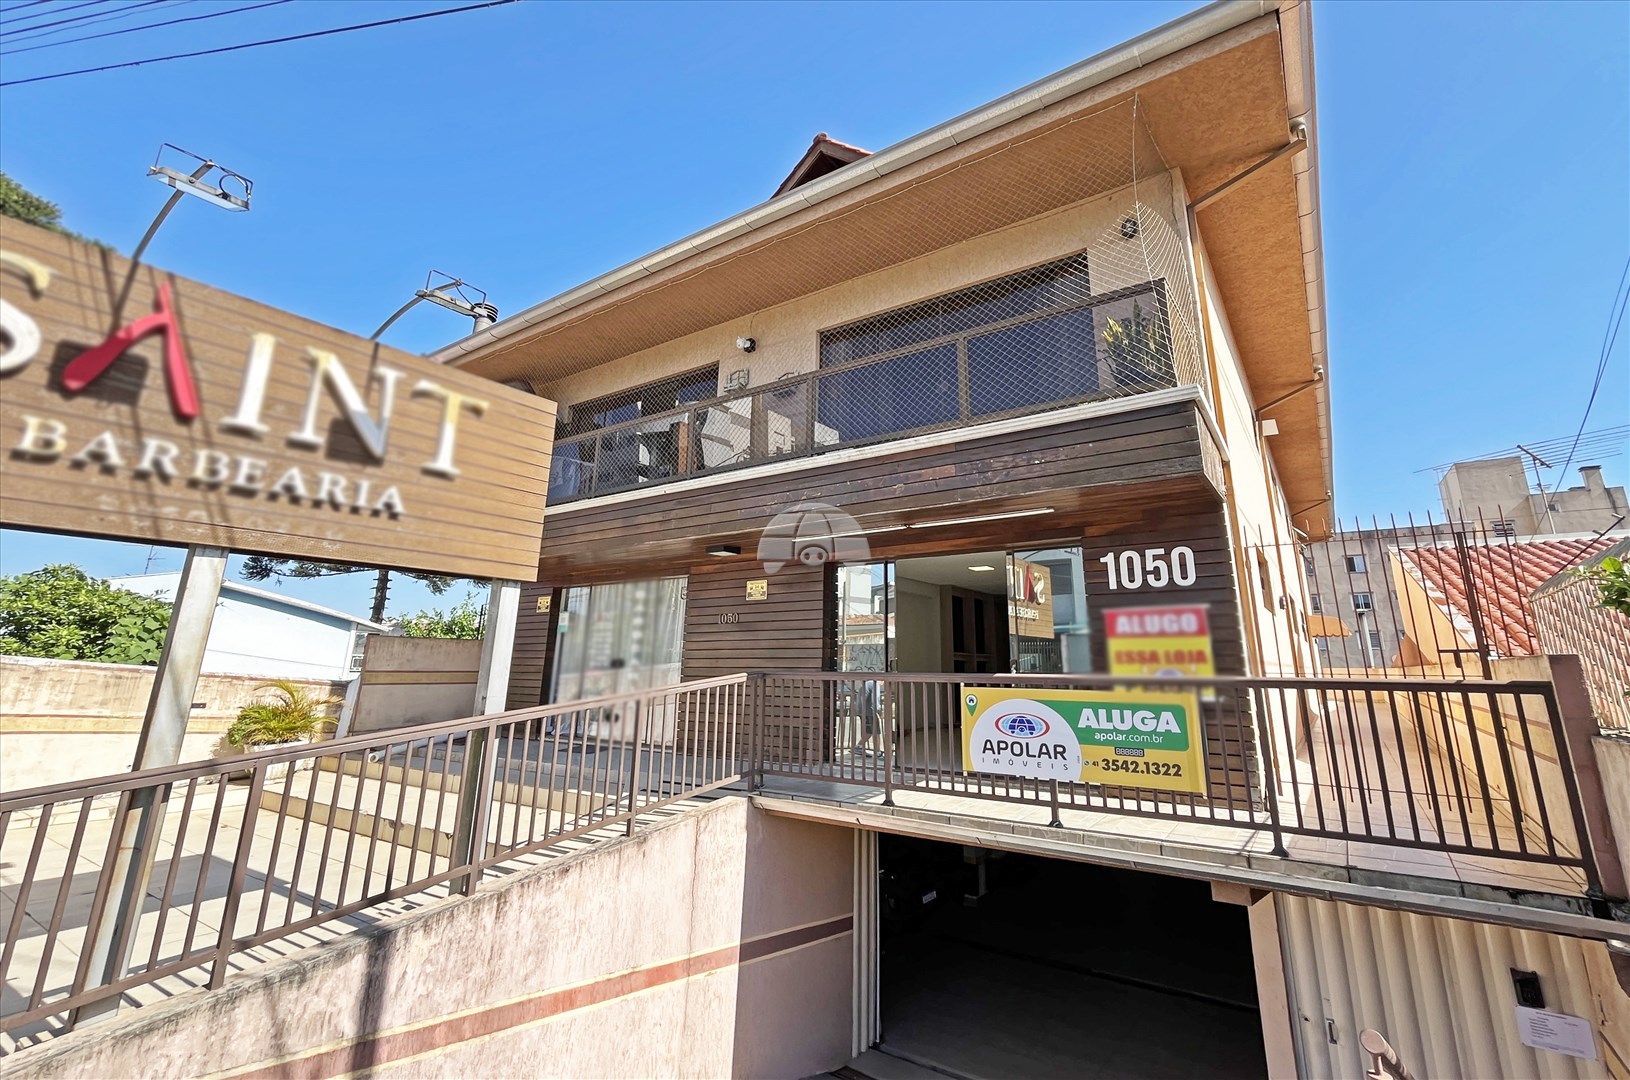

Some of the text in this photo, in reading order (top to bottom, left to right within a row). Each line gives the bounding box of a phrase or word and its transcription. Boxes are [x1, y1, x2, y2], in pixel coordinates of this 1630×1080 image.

[14, 414, 405, 518] BARBEARIA
[1100, 546, 1197, 590] 1050
[1115, 612, 1199, 635] ALUGO
[1114, 649, 1208, 665] ESSA LOJA
[1077, 708, 1182, 734] ALUGA
[1094, 731, 1164, 744] apolar.com.br
[982, 739, 1067, 761] APOLAR
[982, 758, 1069, 771] IMÓVEIS
[1101, 758, 1183, 777] 3542.1322
